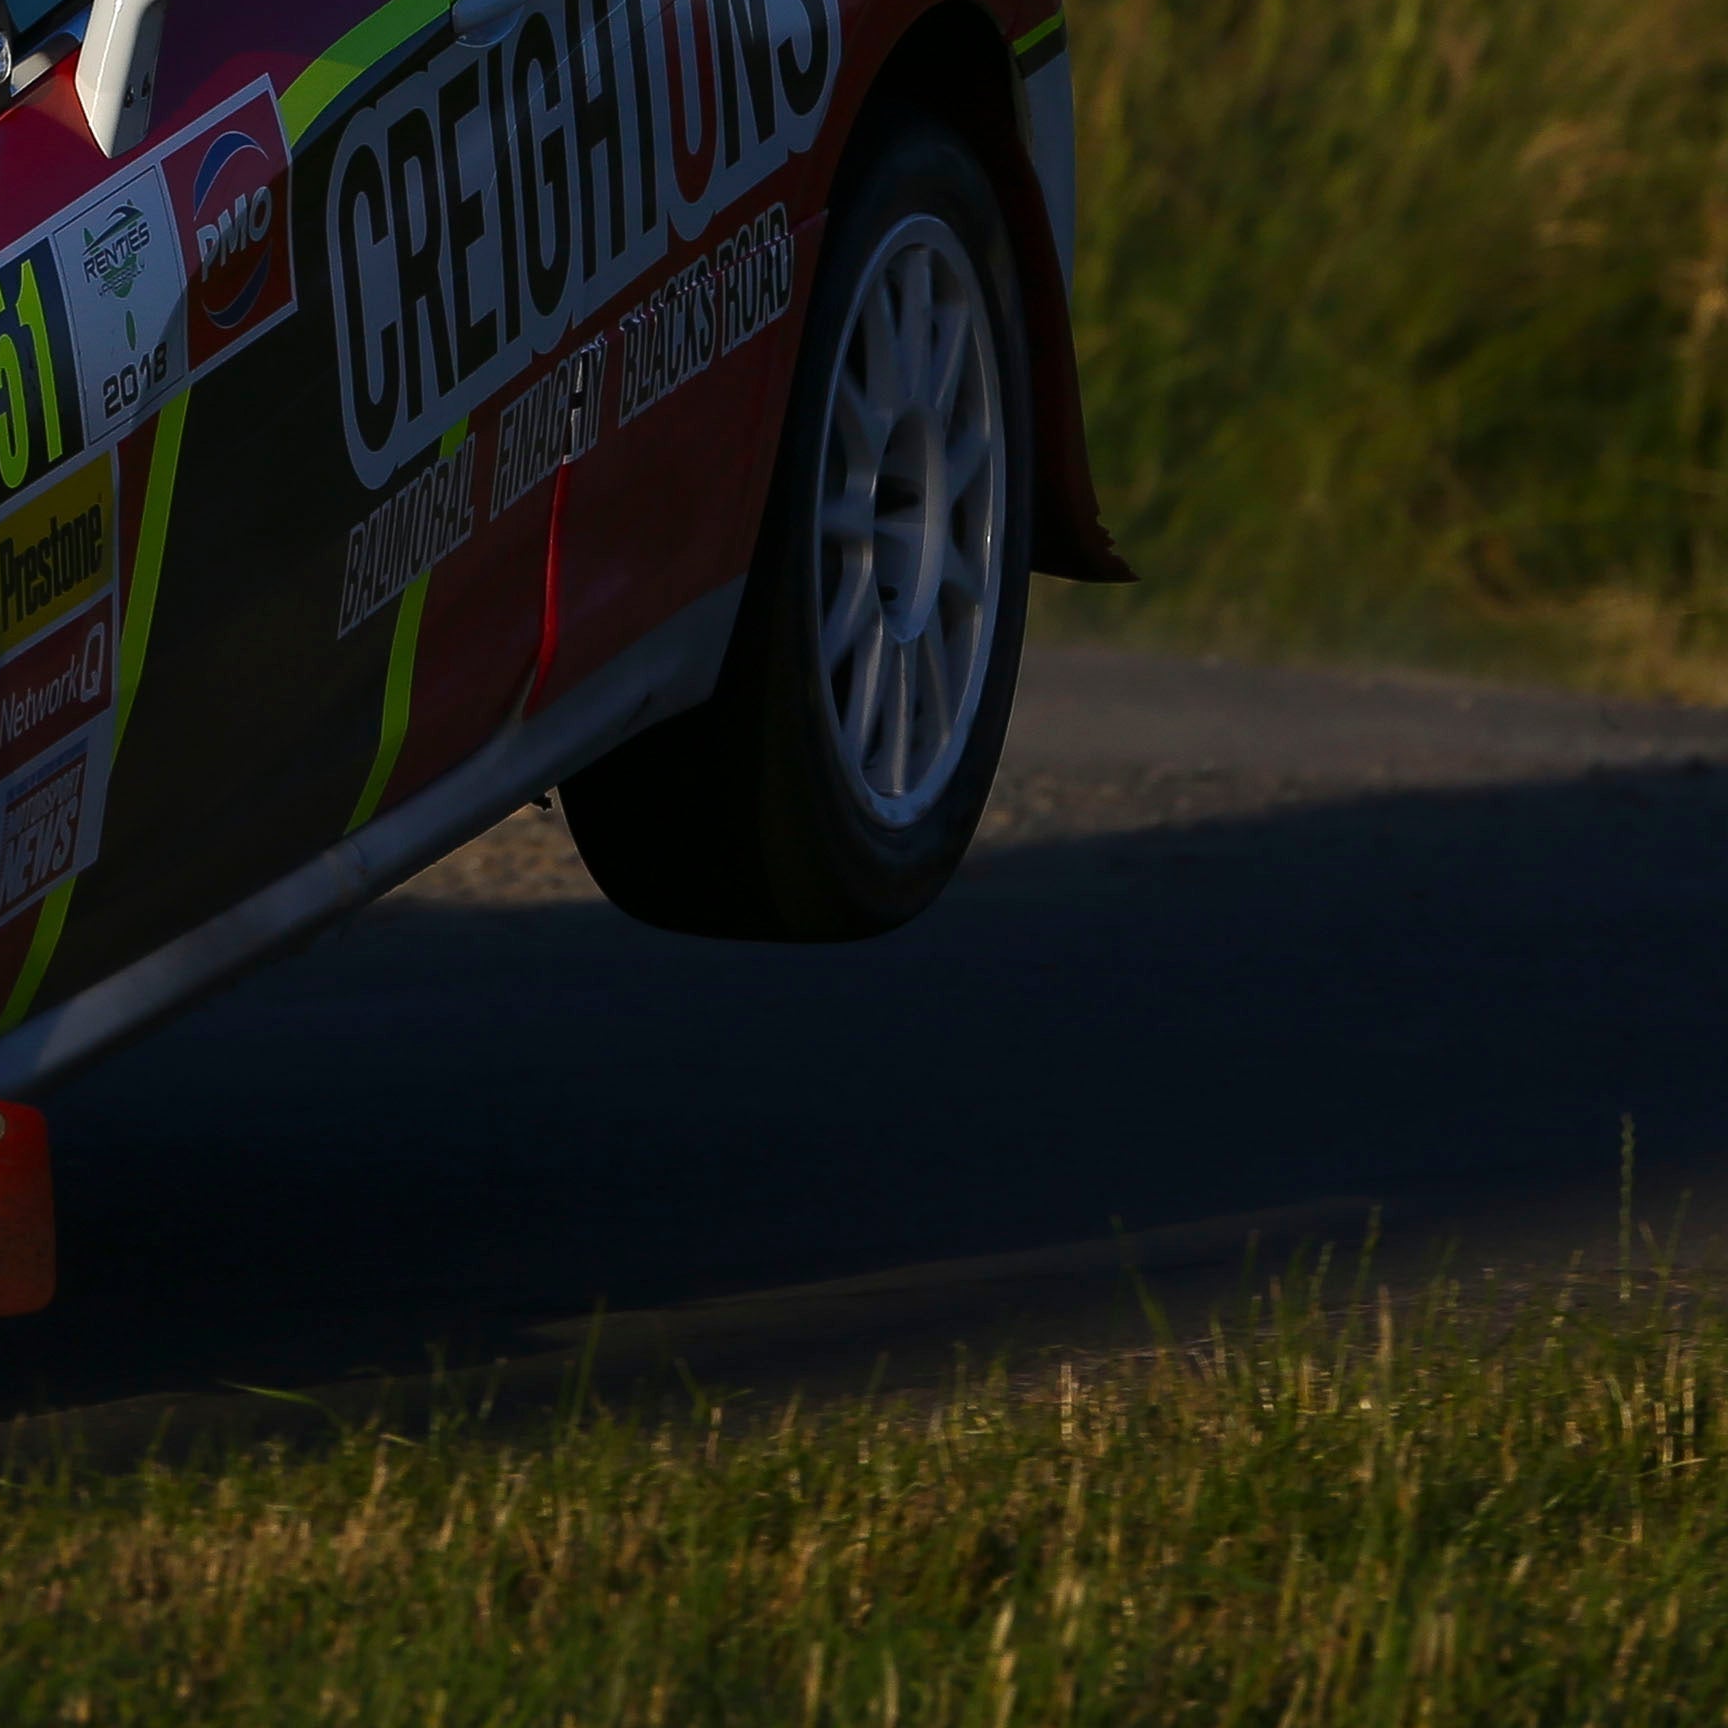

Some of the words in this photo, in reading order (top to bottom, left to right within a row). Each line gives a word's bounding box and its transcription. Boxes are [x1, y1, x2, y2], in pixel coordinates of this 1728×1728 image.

[82, 221, 151, 285] RENTIES
[196, 185, 273, 283] PMO
[715, 200, 795, 358] ROAD
[101, 341, 169, 420] 2018
